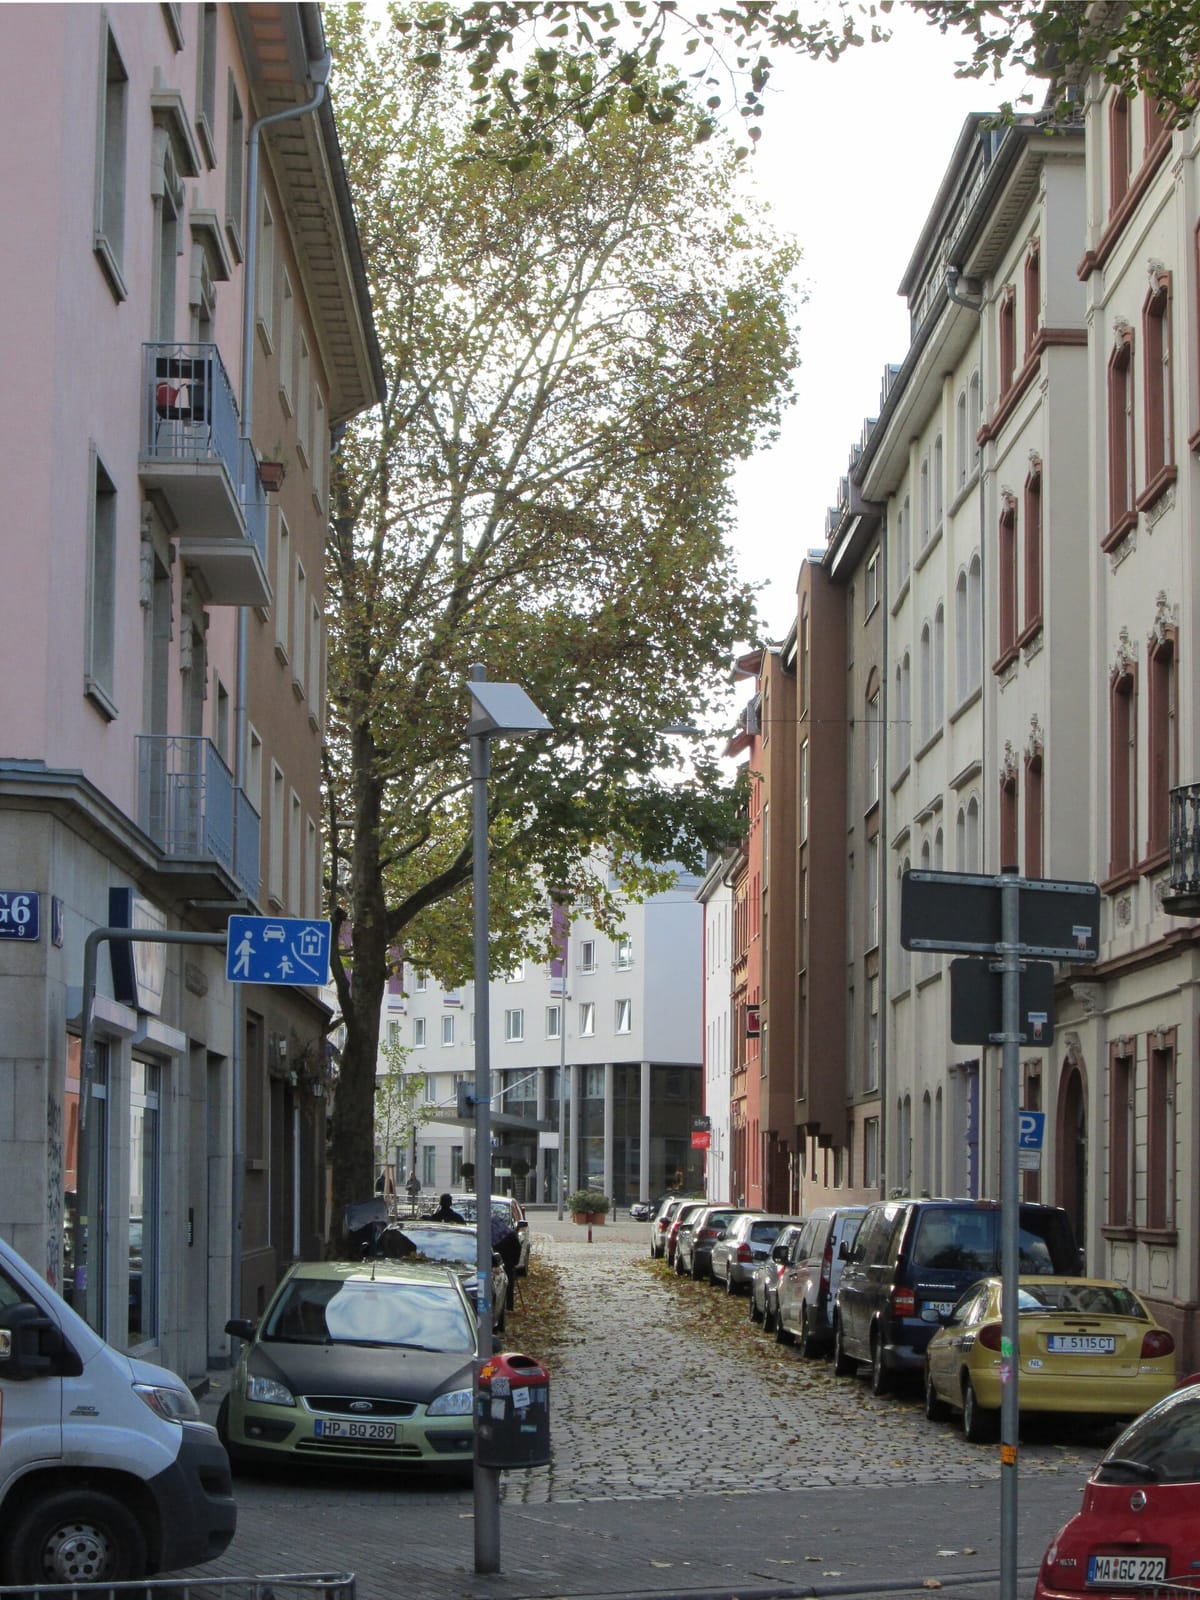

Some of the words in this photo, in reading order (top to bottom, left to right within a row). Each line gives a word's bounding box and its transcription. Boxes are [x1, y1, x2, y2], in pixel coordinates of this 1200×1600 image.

[18, 925, 25, 936] 9
[1019, 1116, 1036, 1146] P
[1059, 1337, 1066, 1347] T
[1030, 1360, 1041, 1368] NL
[323, 1422, 341, 1435] HP
[349, 1423, 367, 1437] BQ
[369, 1425, 394, 1439] 289
[1095, 1559, 1111, 1580] MA
[1119, 1560, 1137, 1580] GC
[1138, 1561, 1164, 1581] 222
